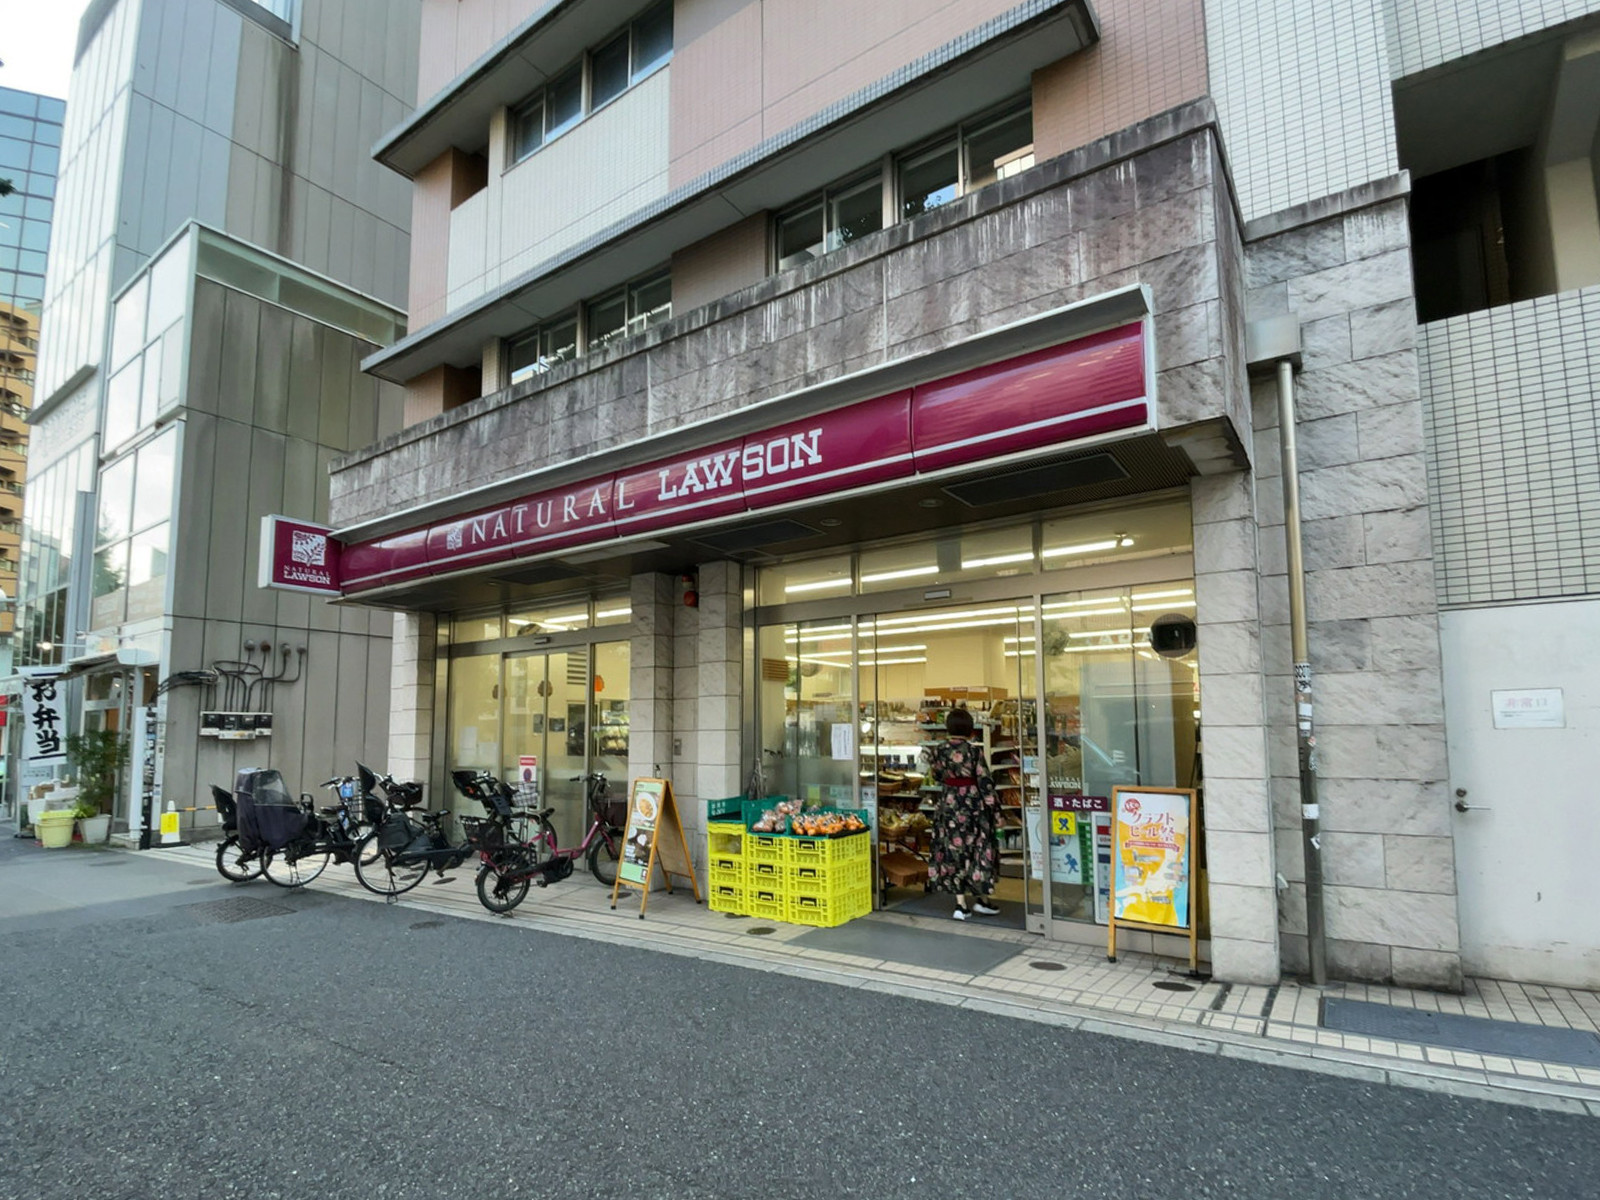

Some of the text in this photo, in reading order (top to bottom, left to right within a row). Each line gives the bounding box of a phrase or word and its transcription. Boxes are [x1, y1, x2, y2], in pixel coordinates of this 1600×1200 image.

[471, 428, 823, 544] NATURAL LAWSON
[283, 565, 330, 576] NATURAL
[283, 570, 331, 585] LAWSON
[29, 678, 61, 755] お弁当
[1053, 797, 1103, 809] 酒・たばこ
